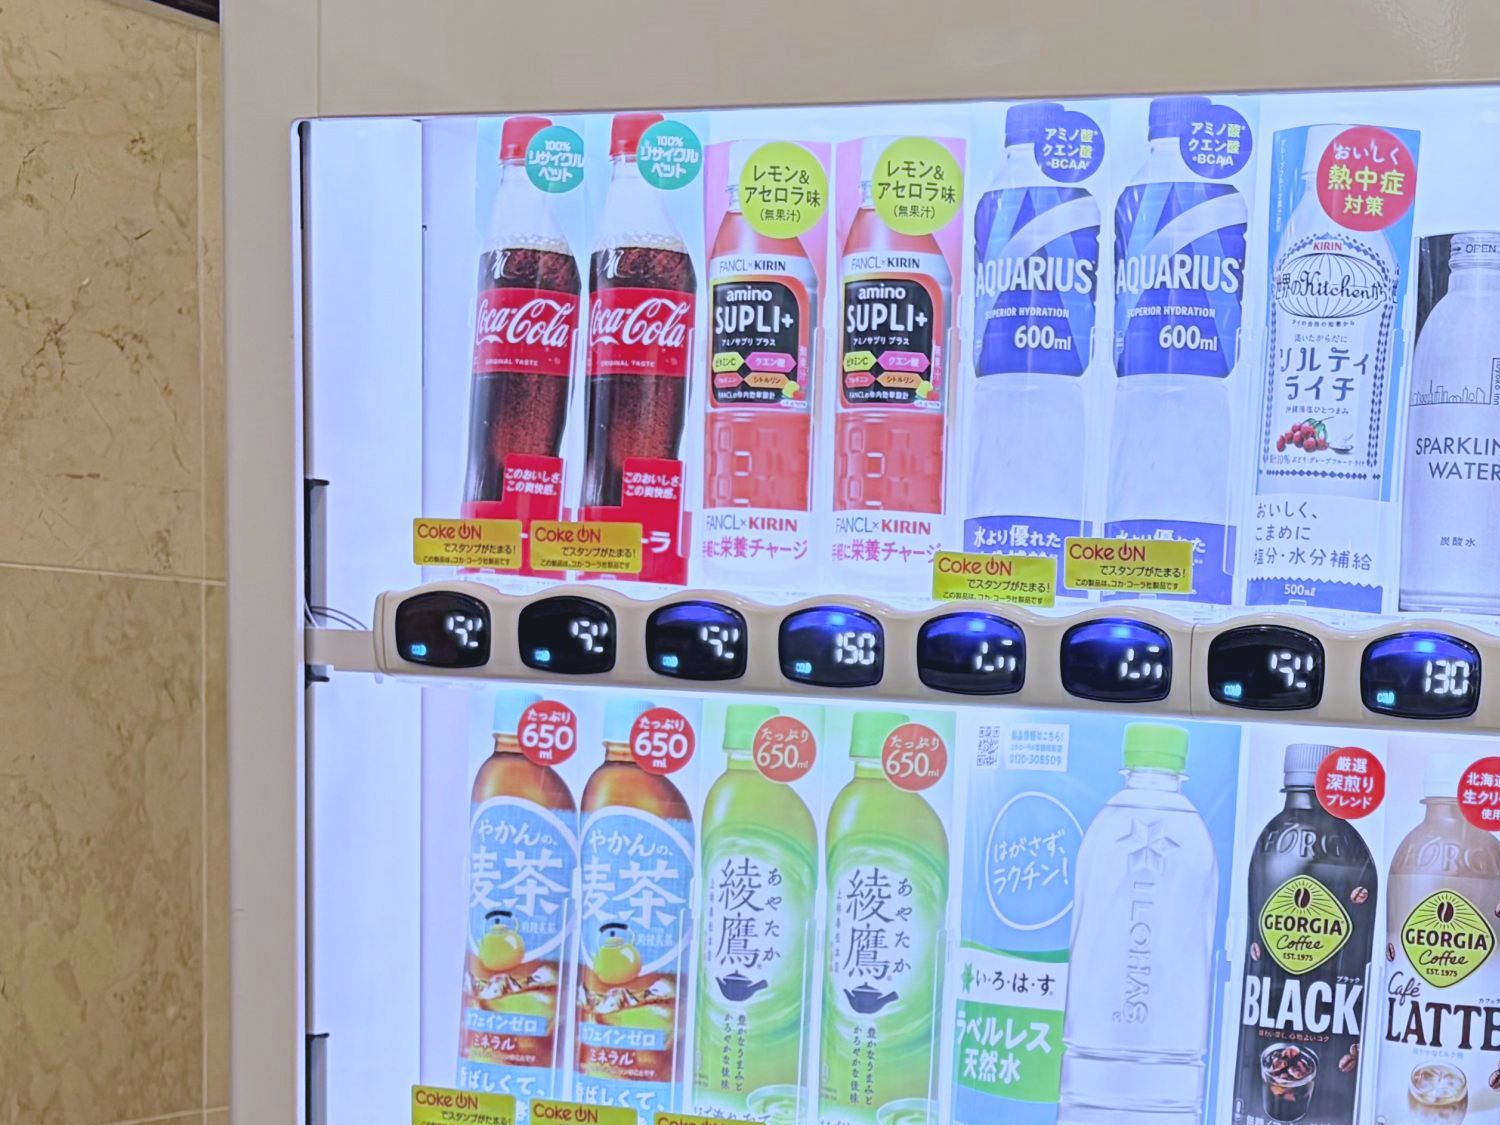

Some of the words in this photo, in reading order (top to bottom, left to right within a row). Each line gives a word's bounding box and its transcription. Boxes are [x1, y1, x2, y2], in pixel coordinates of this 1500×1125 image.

[1042, 143, 1092, 159] クエン酸
[1333, 141, 1400, 163] おいしく
[753, 166, 810, 186] レモン&
[1328, 165, 1405, 196] 熱中症
[745, 187, 820, 207] アセロラ味
[1343, 195, 1384, 218] 対策
[760, 207, 801, 223] (無果汁)
[1465, 243, 1497, 254] OPEN
[976, 255, 1094, 297] AQUARIUS
[858, 285, 906, 301] amino
[589, 298, 690, 348] Coca-Cola
[847, 304, 928, 332] SUPLI+
[1014, 325, 1072, 352] 600ml
[1440, 536, 1476, 547] 炭酸水
[835, 631, 877, 665] 150
[1425, 659, 1470, 695] 130
[638, 717, 684, 732] たっぷり
[635, 732, 687, 759] 650
[653, 757, 666, 769] ml
[1336, 756, 1368, 774] 厳選
[1326, 772, 1374, 794] 深煎り
[1327, 792, 1372, 810] ブレンド
[994, 830, 1066, 861] はがさず、
[994, 856, 1069, 895] ラクチン!
[719, 857, 765, 969] 綾鷹
[1265, 912, 1342, 935] GEORGIA
[1388, 971, 1422, 1000] Café
[1242, 973, 1363, 1037] BLACK
[957, 1010, 1052, 1056] ラベルレス
[963, 1049, 1021, 1085] 天然水
